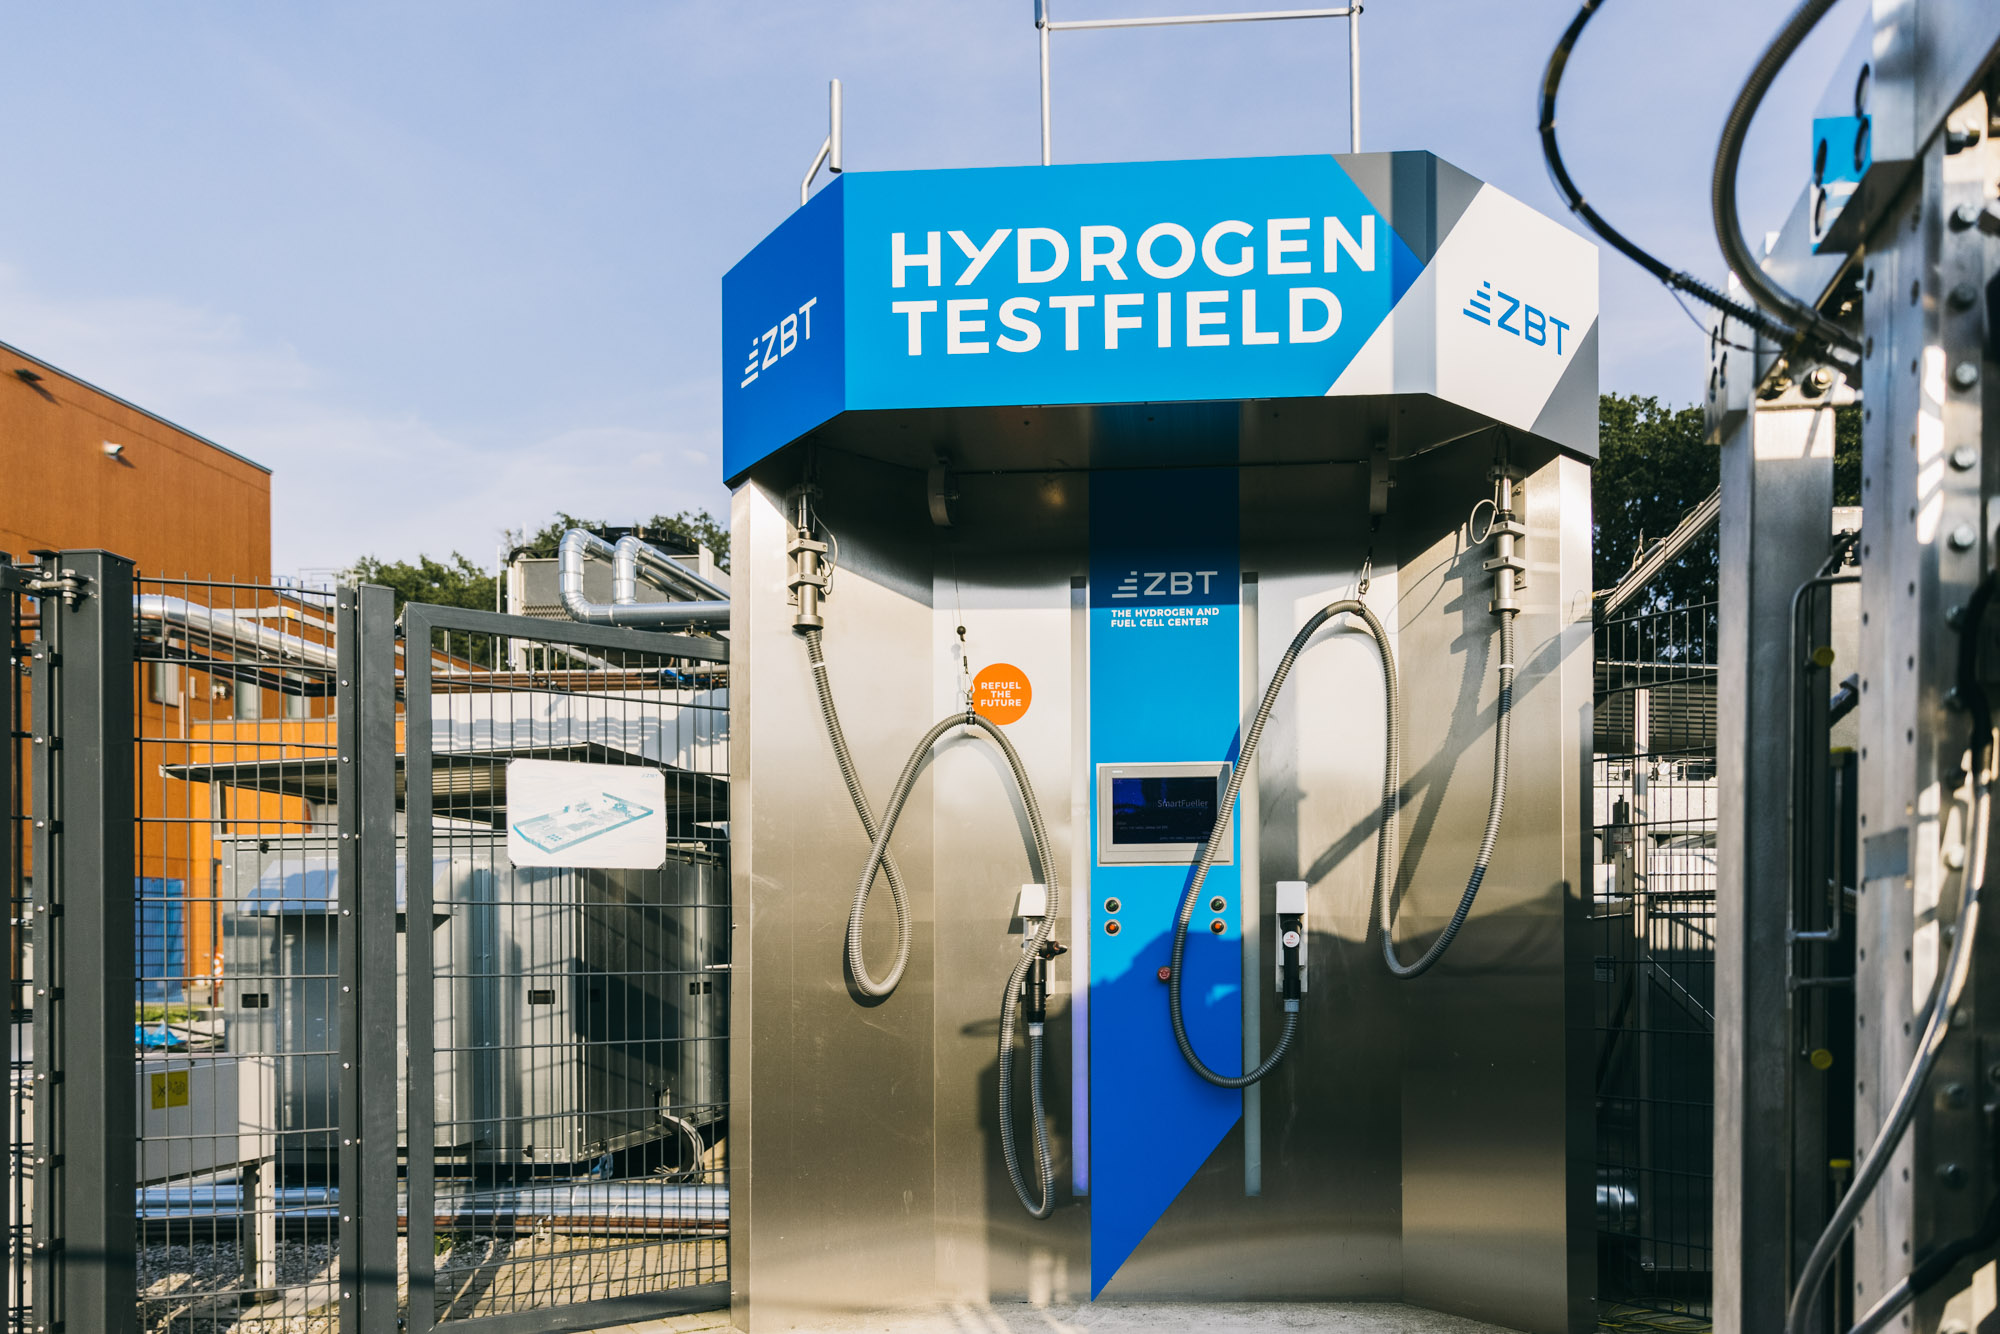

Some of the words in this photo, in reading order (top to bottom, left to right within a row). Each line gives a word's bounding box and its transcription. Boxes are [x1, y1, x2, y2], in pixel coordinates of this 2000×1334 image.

[891, 214, 1376, 288] HYDROGEN
[891, 286, 1343, 356] TESTFIELD
[1497, 290, 1570, 356] ZBT
[761, 296, 817, 371] ZBT
[1143, 571, 1218, 596] ZBT
[1111, 609, 1132, 618] THE
[1135, 608, 1193, 617] HYDROGEN
[1196, 607, 1220, 616] AND
[1110, 619, 1137, 628] FUEL
[1139, 618, 1165, 627] CELL
[1168, 617, 1209, 626] CENTER
[981, 682, 1022, 690] REFUEL
[991, 690, 1011, 698] THE
[980, 699, 1022, 707] FUTURE
[1157, 799, 1209, 808] SmartFueller
